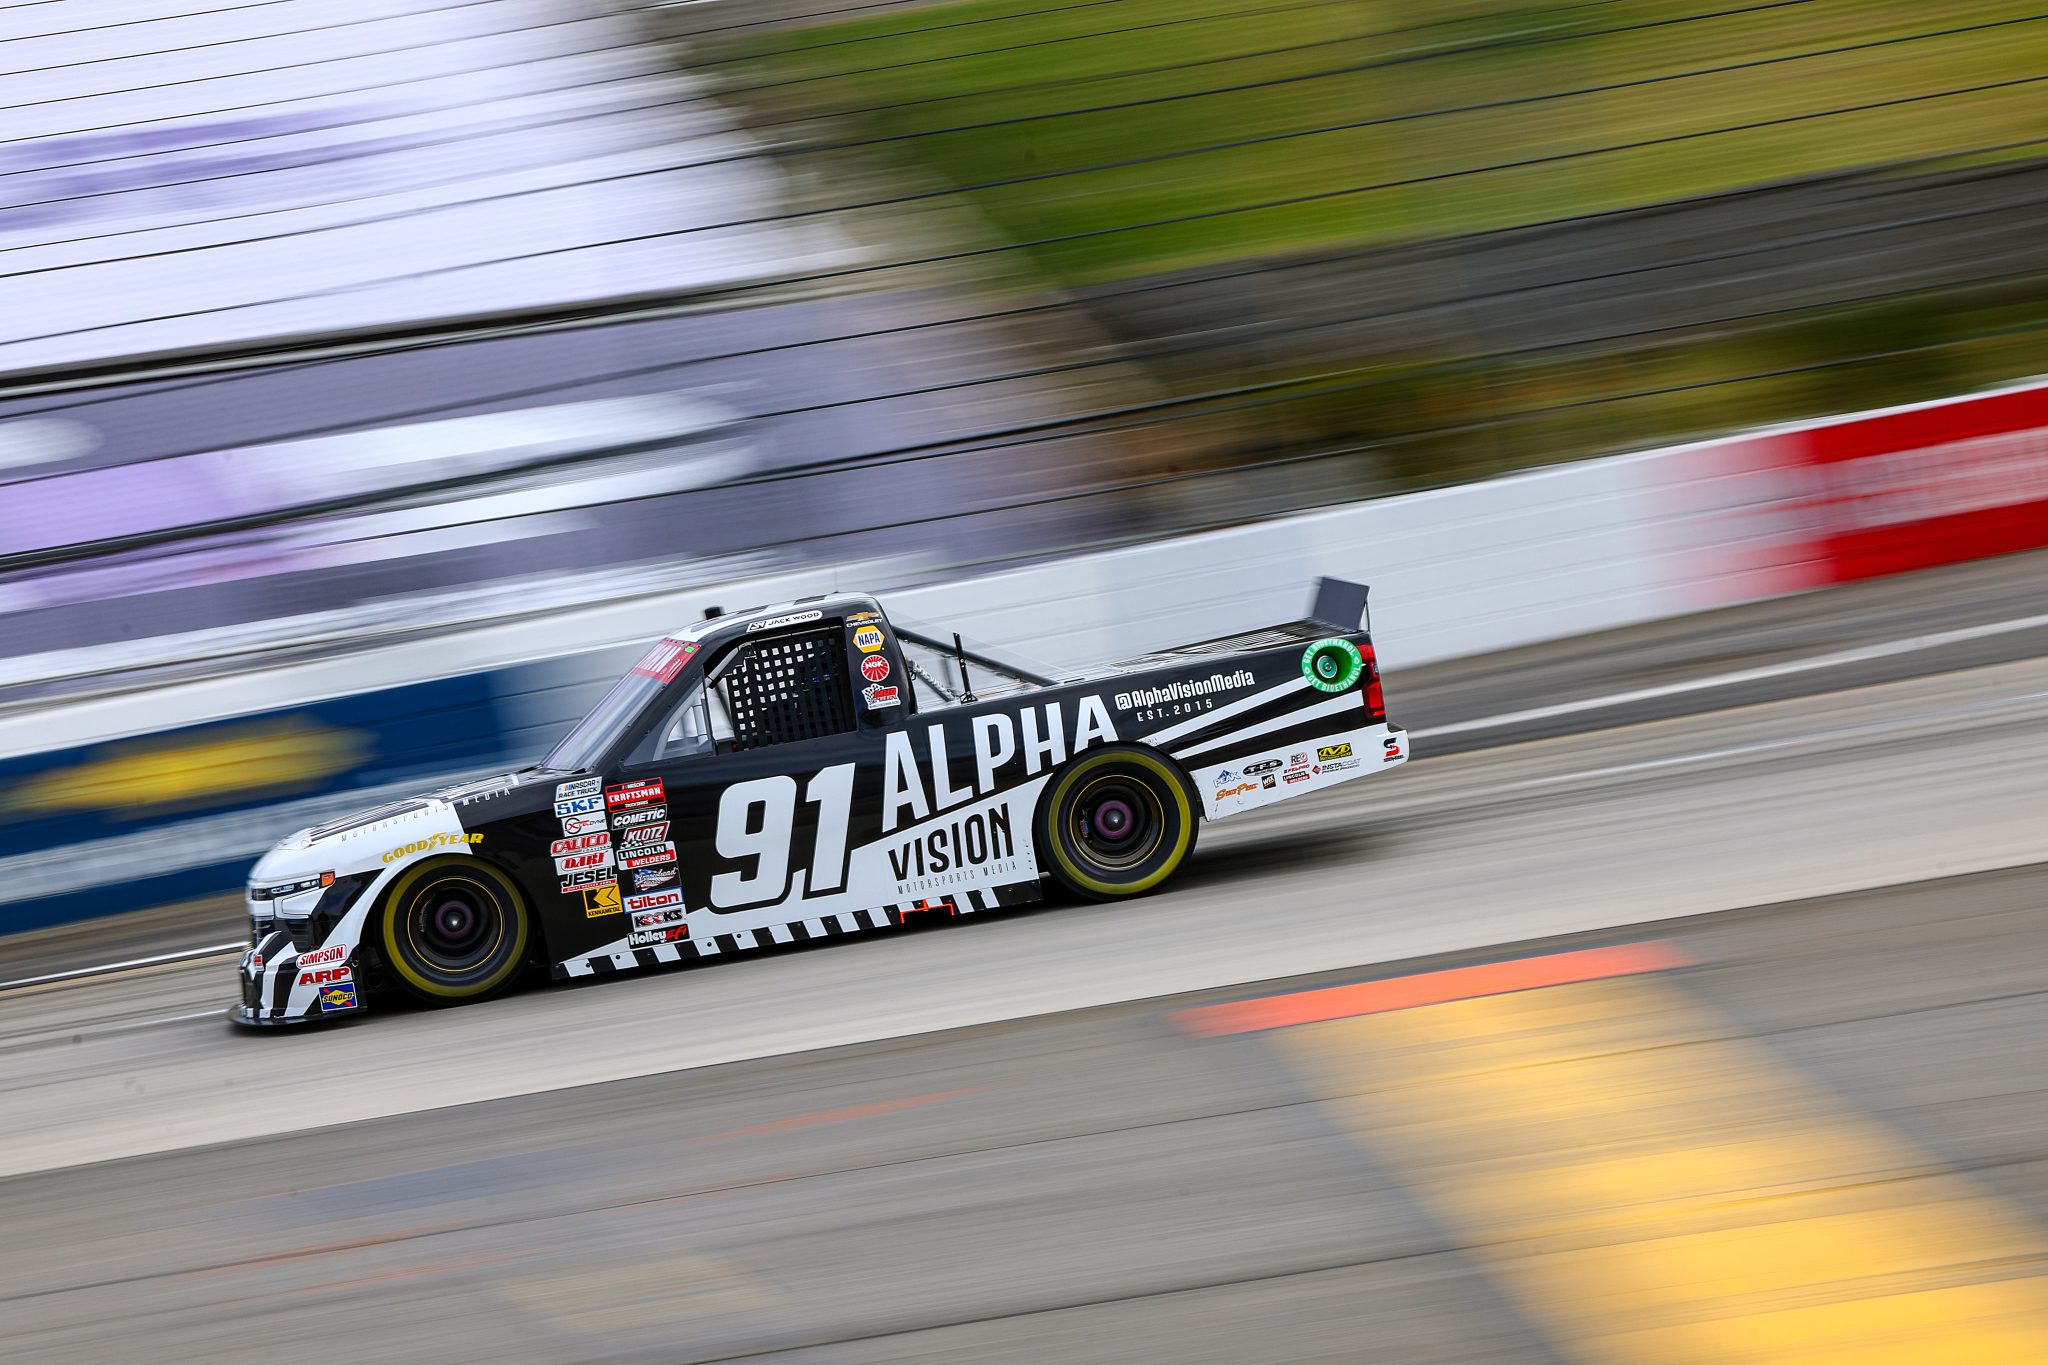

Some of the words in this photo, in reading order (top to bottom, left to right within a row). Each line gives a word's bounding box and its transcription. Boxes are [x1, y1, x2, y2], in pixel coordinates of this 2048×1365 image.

[768, 617, 791, 626] JACK
[793, 612, 820, 621] WOOD
[846, 619, 882, 628] CHEVROLET
[857, 632, 881, 646] NAPA
[1303, 649, 1313, 664] GET
[1311, 638, 1356, 657] BIOETHANOL
[865, 660, 884, 669] NGK
[1308, 674, 1322, 689] GET
[1321, 667, 1361, 693] BIOETHANOL
[1114, 669, 1255, 711] @AlphaVisionMedia
[1173, 698, 1213, 715] 2015
[882, 694, 1119, 833] ALPHA
[567, 780, 597, 792] NASCAR
[1213, 770, 1242, 788] PEAK
[1262, 775, 1275, 785] WIX
[461, 786, 512, 807] MEDIA
[558, 790, 576, 799] RACE
[577, 786, 598, 797] TRUCK
[608, 787, 661, 803] CRAFTSMAN
[556, 796, 602, 816] SKF
[613, 808, 666, 827] COMETIC
[628, 826, 664, 842] KLOTZ
[710, 762, 857, 909] 91
[887, 802, 1014, 882] VISION
[382, 832, 485, 865] GOODYEAR
[552, 833, 610, 855] CALICO
[619, 845, 665, 860] LINCOLN
[632, 853, 671, 866] WELDERS
[561, 867, 617, 888] JESEL
[898, 870, 976, 896] MOTORSPORTS
[983, 860, 1018, 877] MEDIA
[627, 892, 680, 910] tilton
[588, 906, 621, 917] KENNAMETAL
[635, 908, 684, 928] KOOKS
[628, 930, 667, 946] Holley
[299, 946, 345, 966] SIMPSON
[298, 967, 351, 987] ARP
[322, 991, 355, 1004] SUNOCO
